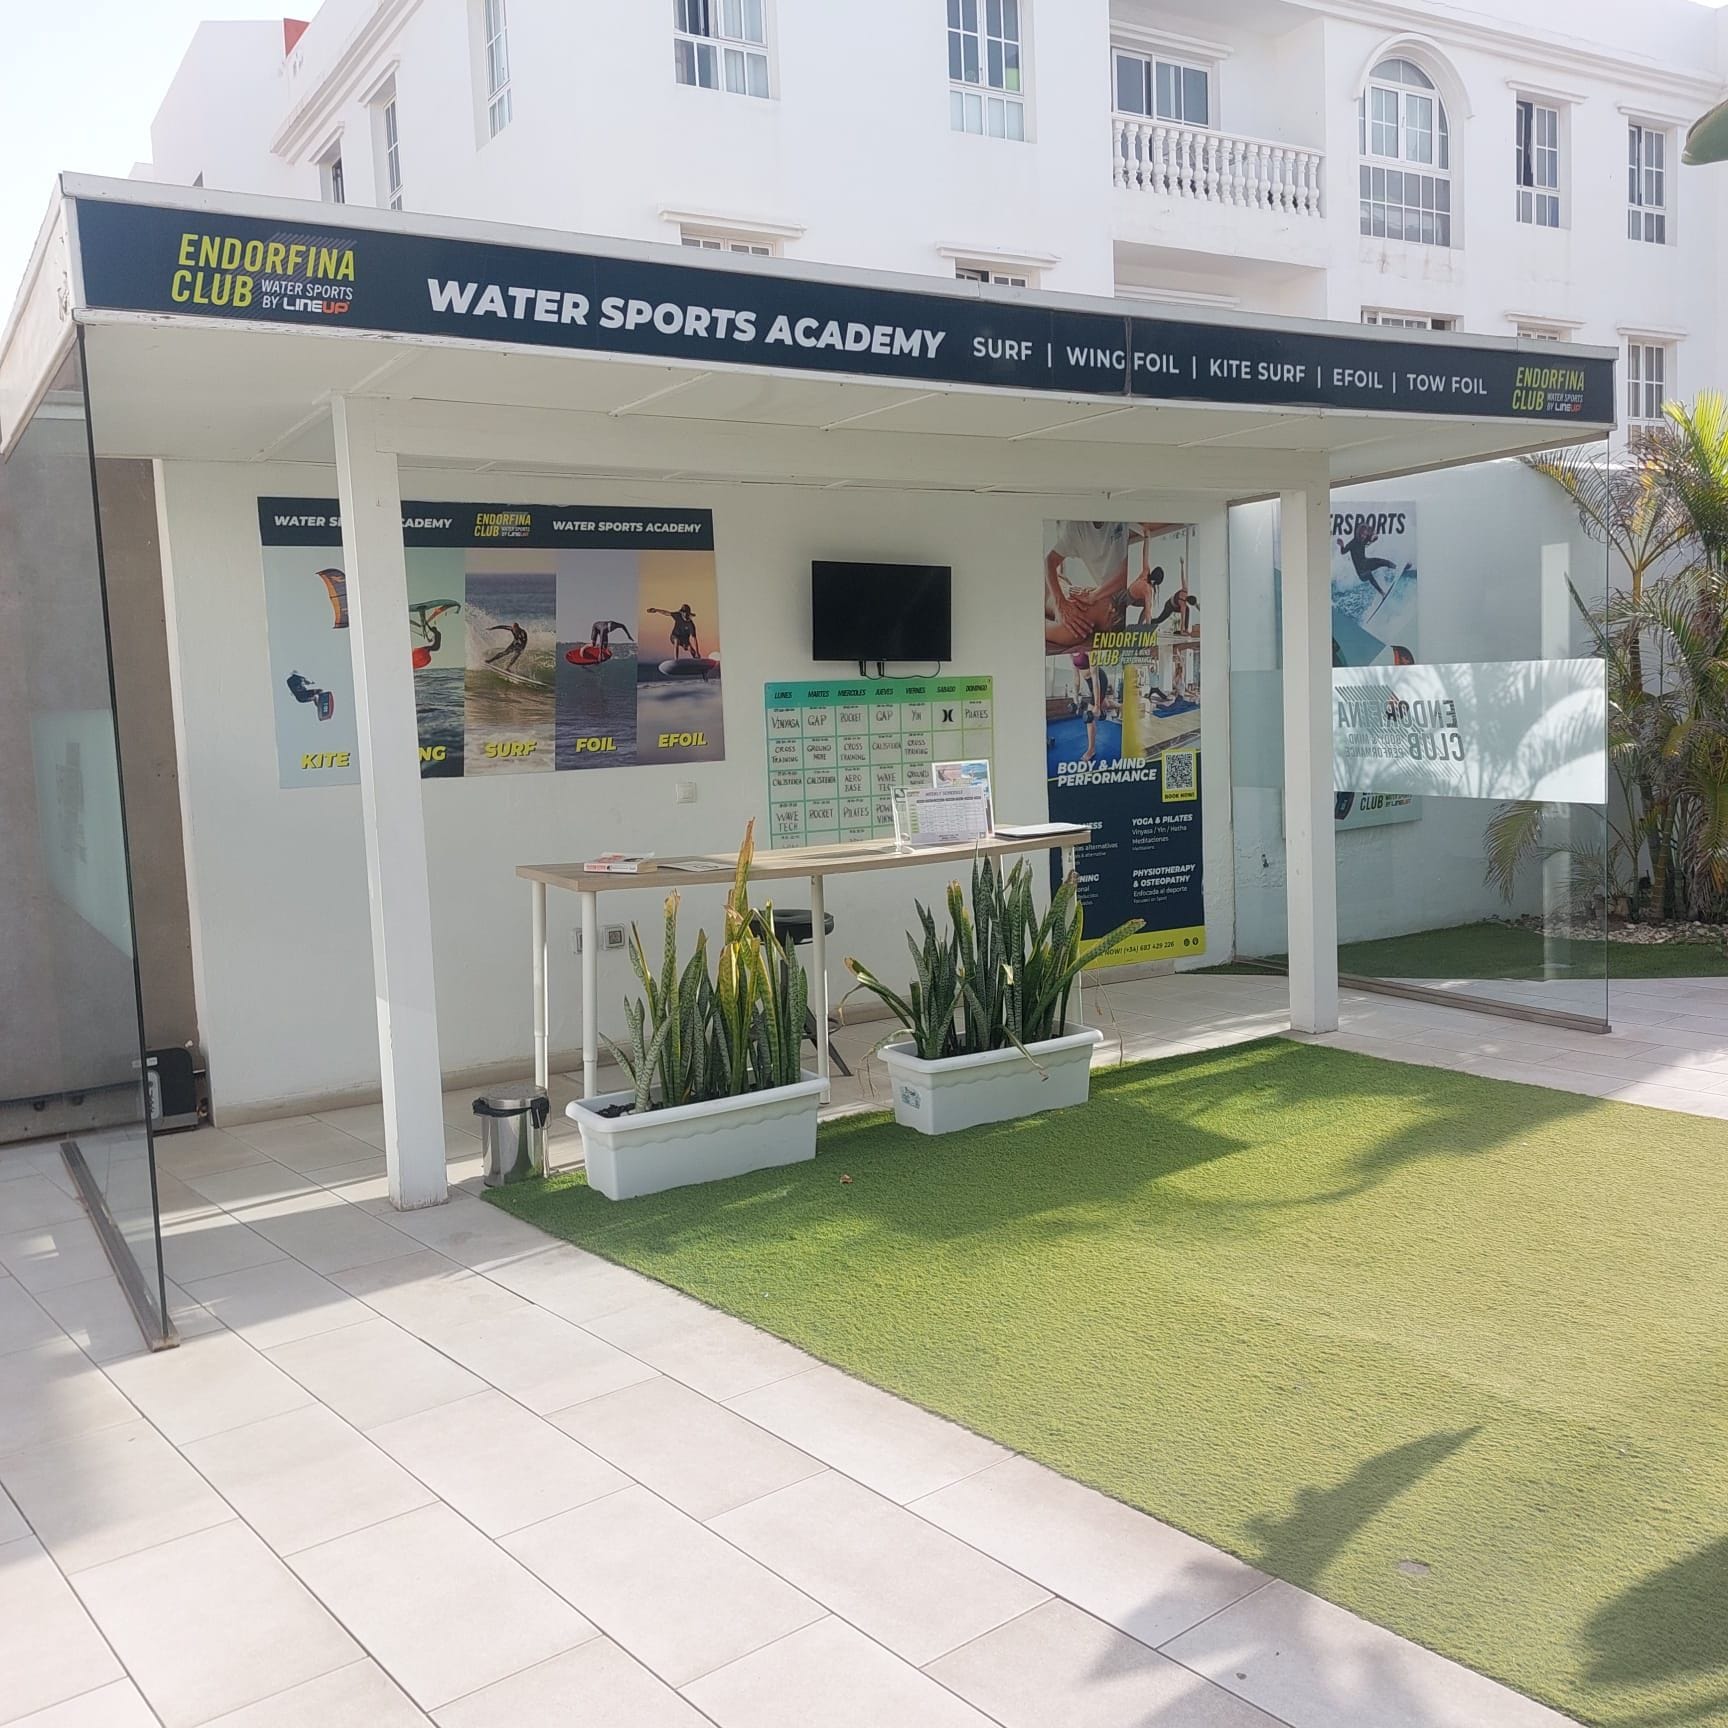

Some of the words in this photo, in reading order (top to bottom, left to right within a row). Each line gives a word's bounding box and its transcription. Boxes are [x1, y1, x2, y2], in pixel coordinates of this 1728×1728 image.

[178, 233, 355, 281] ENDORFINA
[171, 269, 254, 307] CLUB
[261, 279, 303, 296] WATER
[305, 283, 353, 300] SPORTS
[262, 295, 278, 309] BY
[427, 278, 590, 326] WATER
[599, 296, 757, 341] SPORTS
[764, 315, 946, 358] ACADEMY
[973, 337, 1033, 361] SURF
[1066, 346, 1126, 370] WING
[1133, 352, 1180, 374] FOIL
[1210, 358, 1251, 380] KITE
[1257, 362, 1306, 383] SURF
[1333, 368, 1383, 389] EFOIL
[1407, 373, 1446, 393] TOW
[1452, 377, 1488, 395] FOIL
[1515, 366, 1585, 392] ENDORFINA
[1512, 389, 1545, 411] CLUB
[1546, 392, 1564, 402] WATER
[1564, 393, 1584, 403] SPORTS
[1547, 402, 1555, 411] BY
[274, 515, 325, 527] WATER
[476, 513, 531, 526] ENDORFINA
[553, 521, 595, 532] WATER
[598, 522, 643, 532] SPORTS
[646, 522, 701, 533] ACADEMY
[474, 525, 500, 537] CLUB
[1093, 631, 1159, 648] ENDORFINA
[1088, 649, 1120, 666] CLUB
[774, 691, 793, 699] LUNES
[808, 690, 830, 698] MARTES
[875, 687, 894, 696] JUEVES
[576, 737, 617, 752] FOIL
[658, 732, 708, 748] EFOIL
[483, 741, 537, 758] SURF
[301, 752, 350, 769] KITE
[1057, 760, 1096, 774] BODY
[1098, 759, 1109, 771] &
[1110, 758, 1146, 770] MIND
[1057, 769, 1157, 787] PERFORMANCE
[1360, 795, 1384, 811] CLUB
[1132, 817, 1153, 826] YOGA
[1155, 816, 1161, 824] &
[1162, 814, 1193, 824] PILATES
[1133, 863, 1196, 877] PHYSIOTHERAPY
[1133, 880, 1139, 888] &
[1140, 875, 1191, 887] OSTEOPATHY
